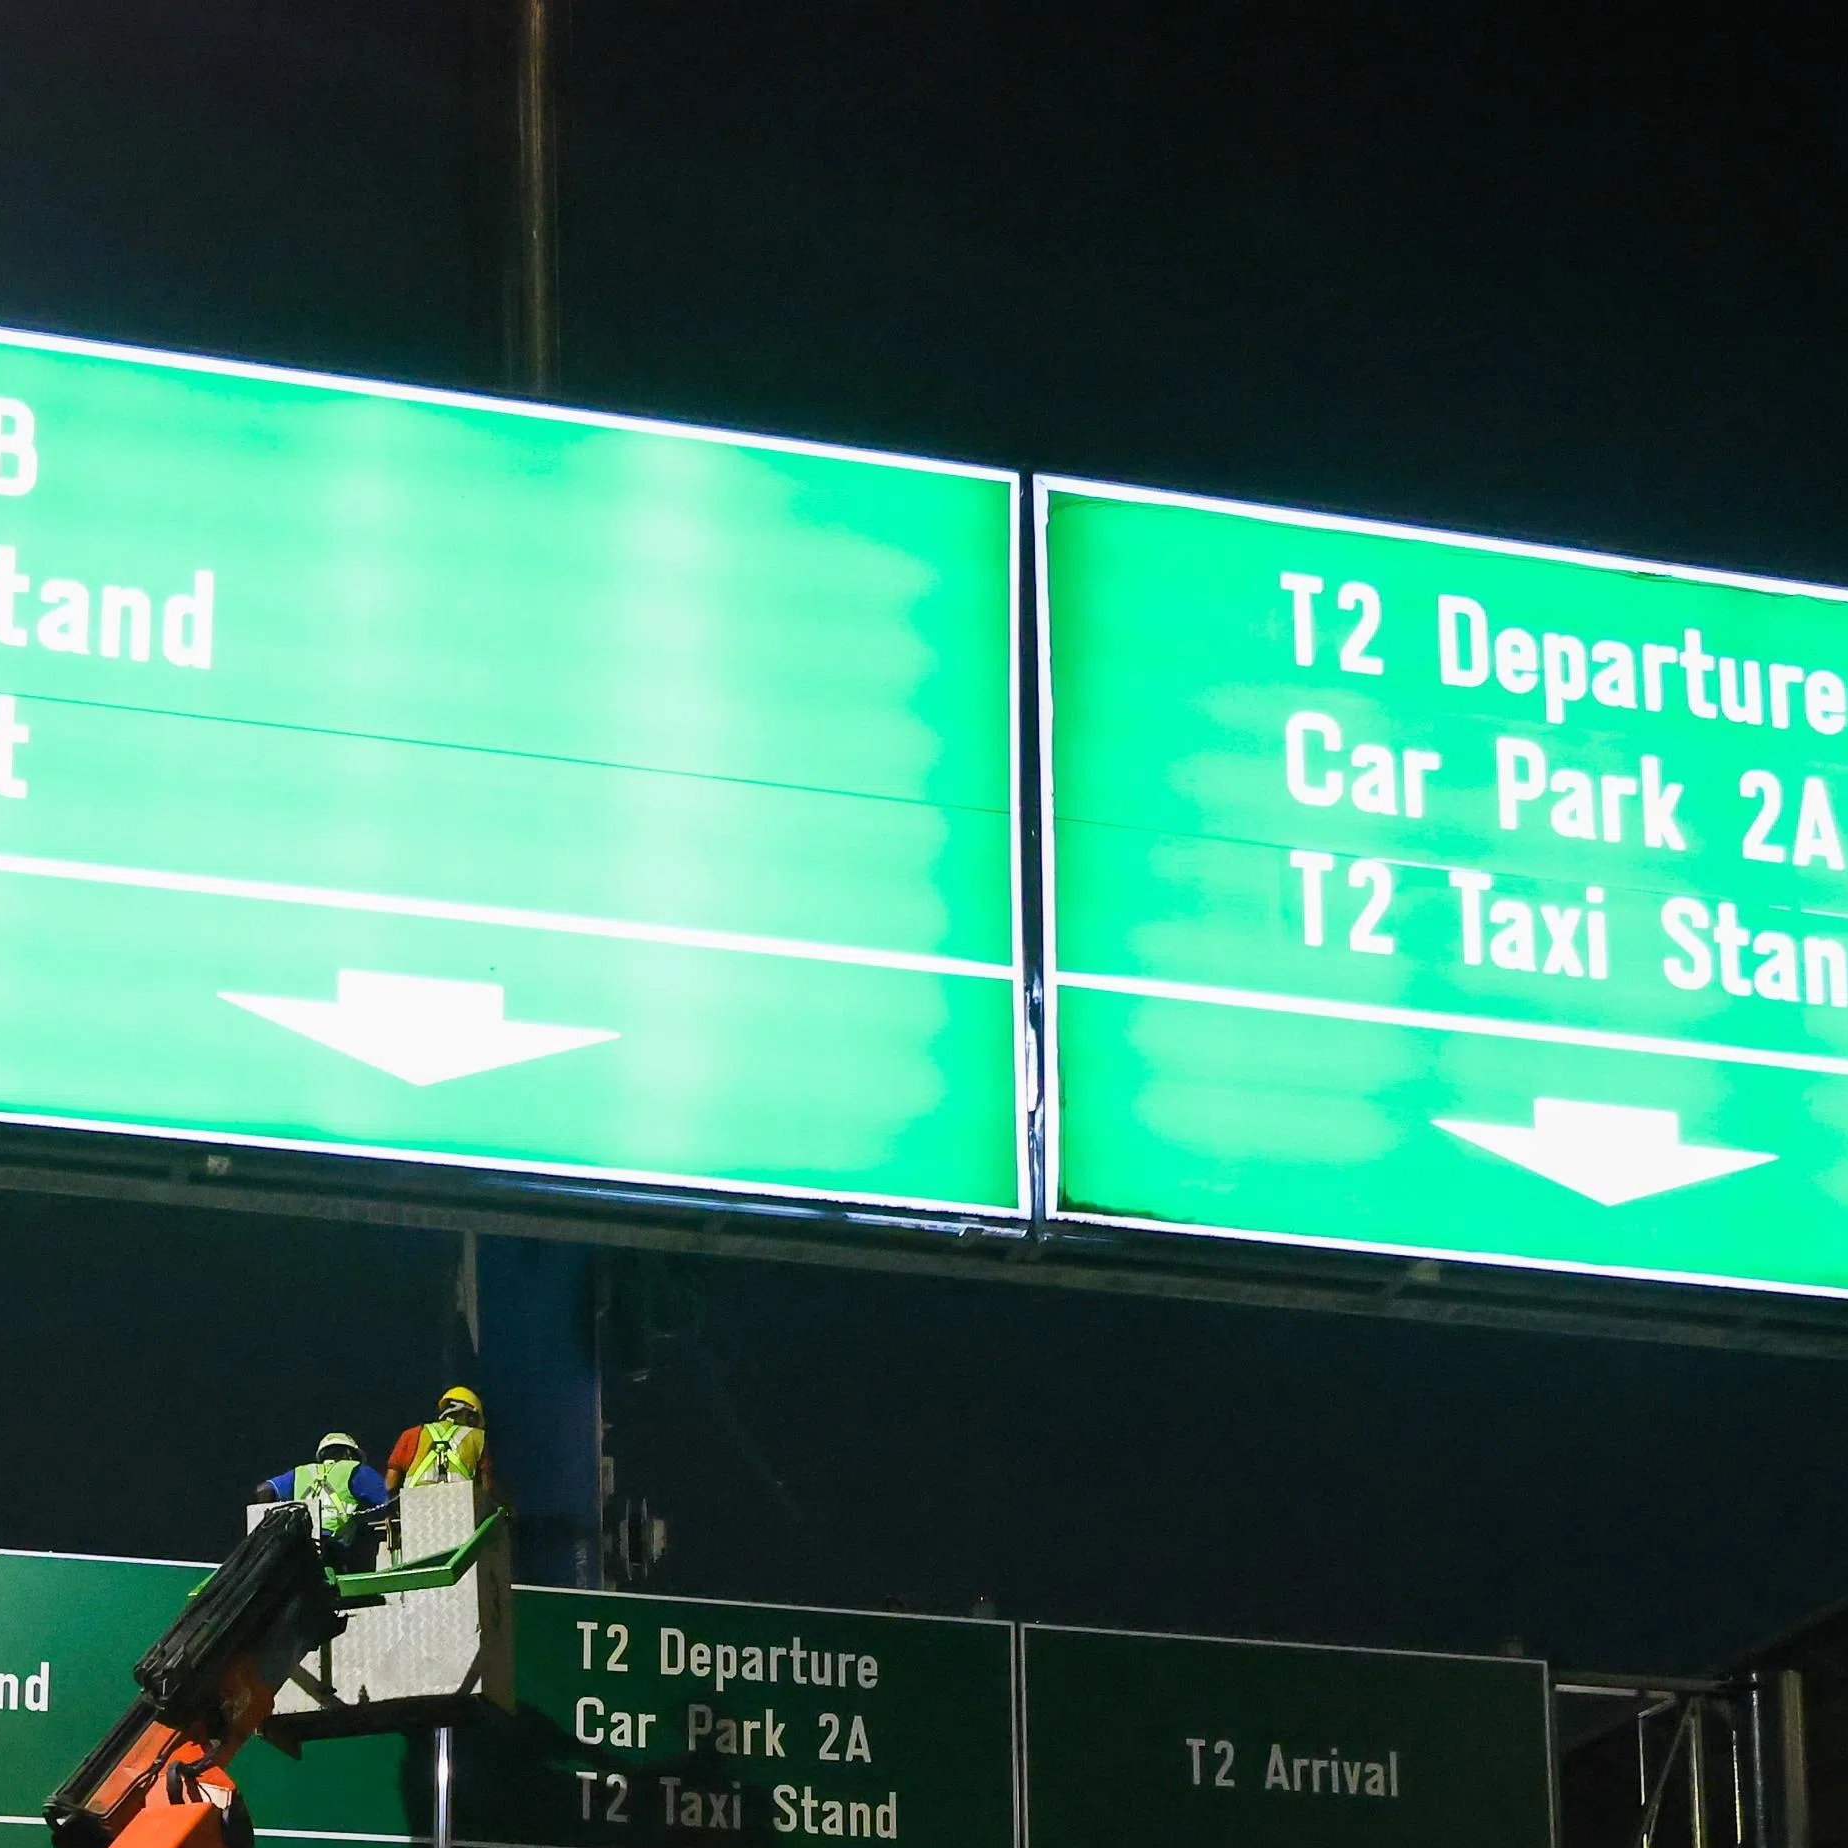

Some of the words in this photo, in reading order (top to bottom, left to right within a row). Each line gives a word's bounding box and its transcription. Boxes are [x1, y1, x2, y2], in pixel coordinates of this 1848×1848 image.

[1280, 571, 1384, 676] T2
[1438, 594, 1847, 735] Departure
[1285, 711, 1442, 819] Car
[1496, 737, 1687, 851] Park
[1739, 769, 1846, 870] 2A
[1289, 850, 1394, 955] T2
[1449, 869, 1608, 980] Taxi
[576, 1621, 629, 1673] T2
[660, 1627, 879, 1692] Departure
[576, 1696, 656, 1748] Car
[688, 1703, 786, 1758] Park
[818, 1712, 872, 1764] 2A
[1185, 1738, 1235, 1788] T2
[1265, 1743, 1398, 1797] Arrival
[575, 1771, 628, 1824] T2
[659, 1776, 741, 1830] Taxi
[773, 1783, 898, 1840] Stand
